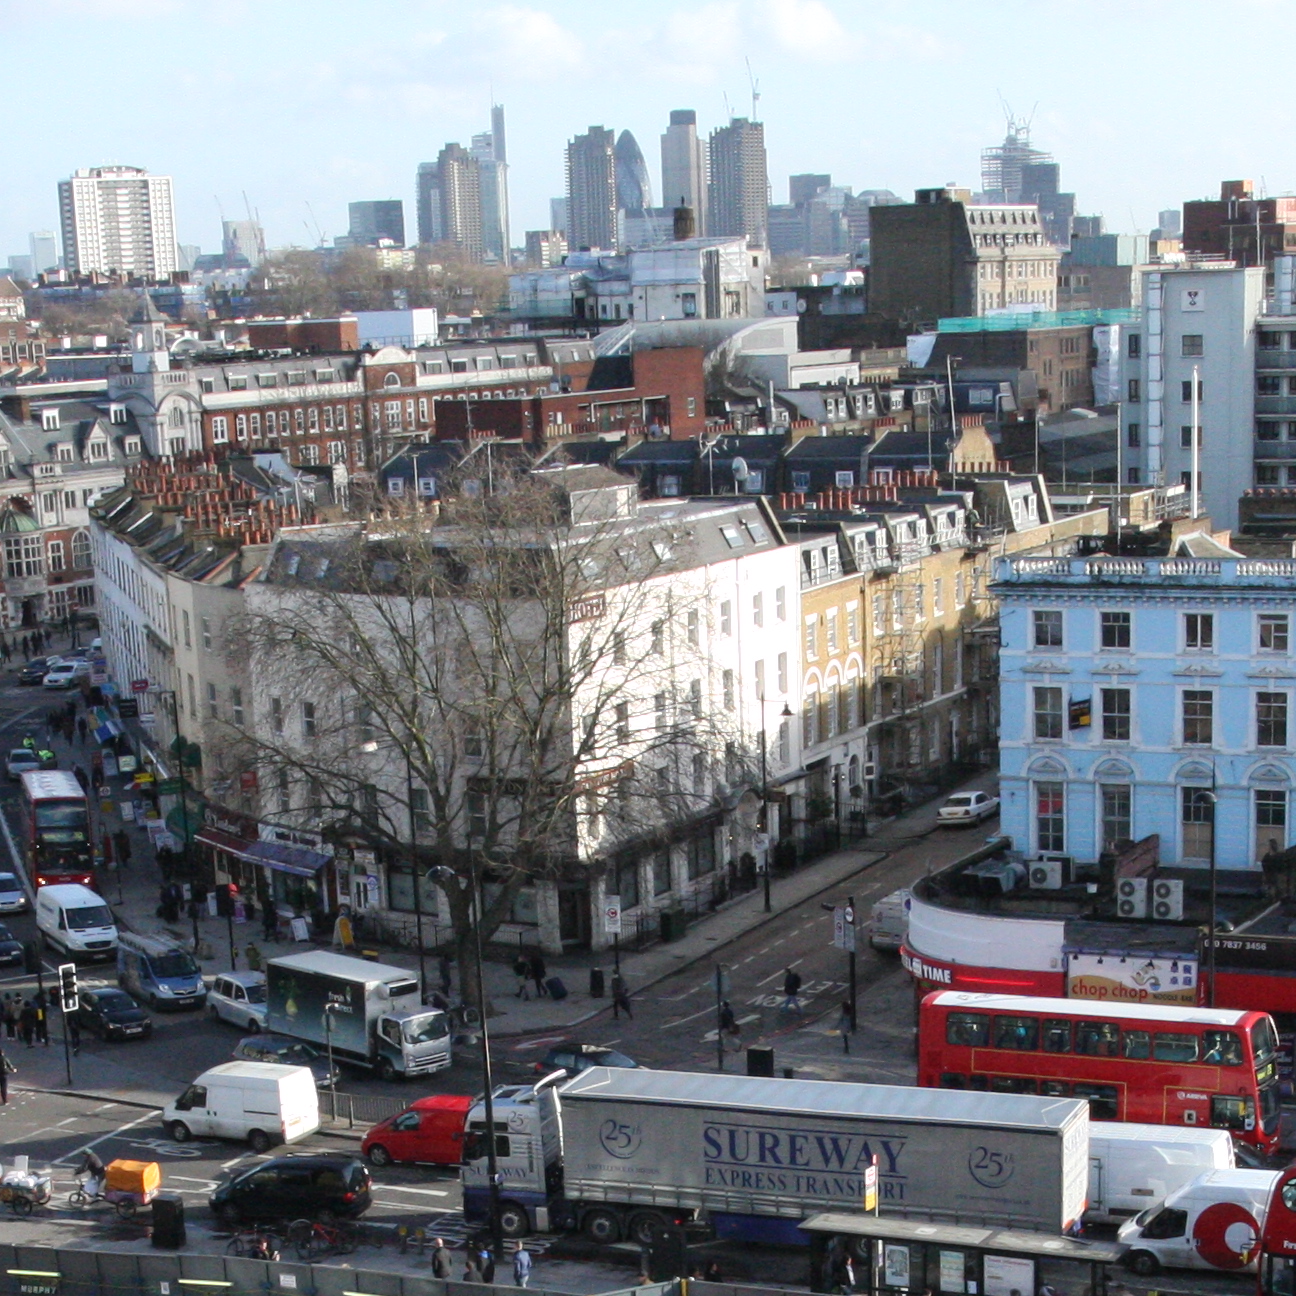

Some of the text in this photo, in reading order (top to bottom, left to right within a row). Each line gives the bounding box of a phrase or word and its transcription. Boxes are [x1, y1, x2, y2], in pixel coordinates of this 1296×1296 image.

[1204, 940, 1220, 948] 00
[922, 965, 952, 984] TIME
[1072, 979, 1149, 1002] chop chop
[703, 1126, 907, 1174] SUREWAY
[705, 1167, 787, 1192] EXPRESS
[20, 1284, 56, 1295] MURPHY
